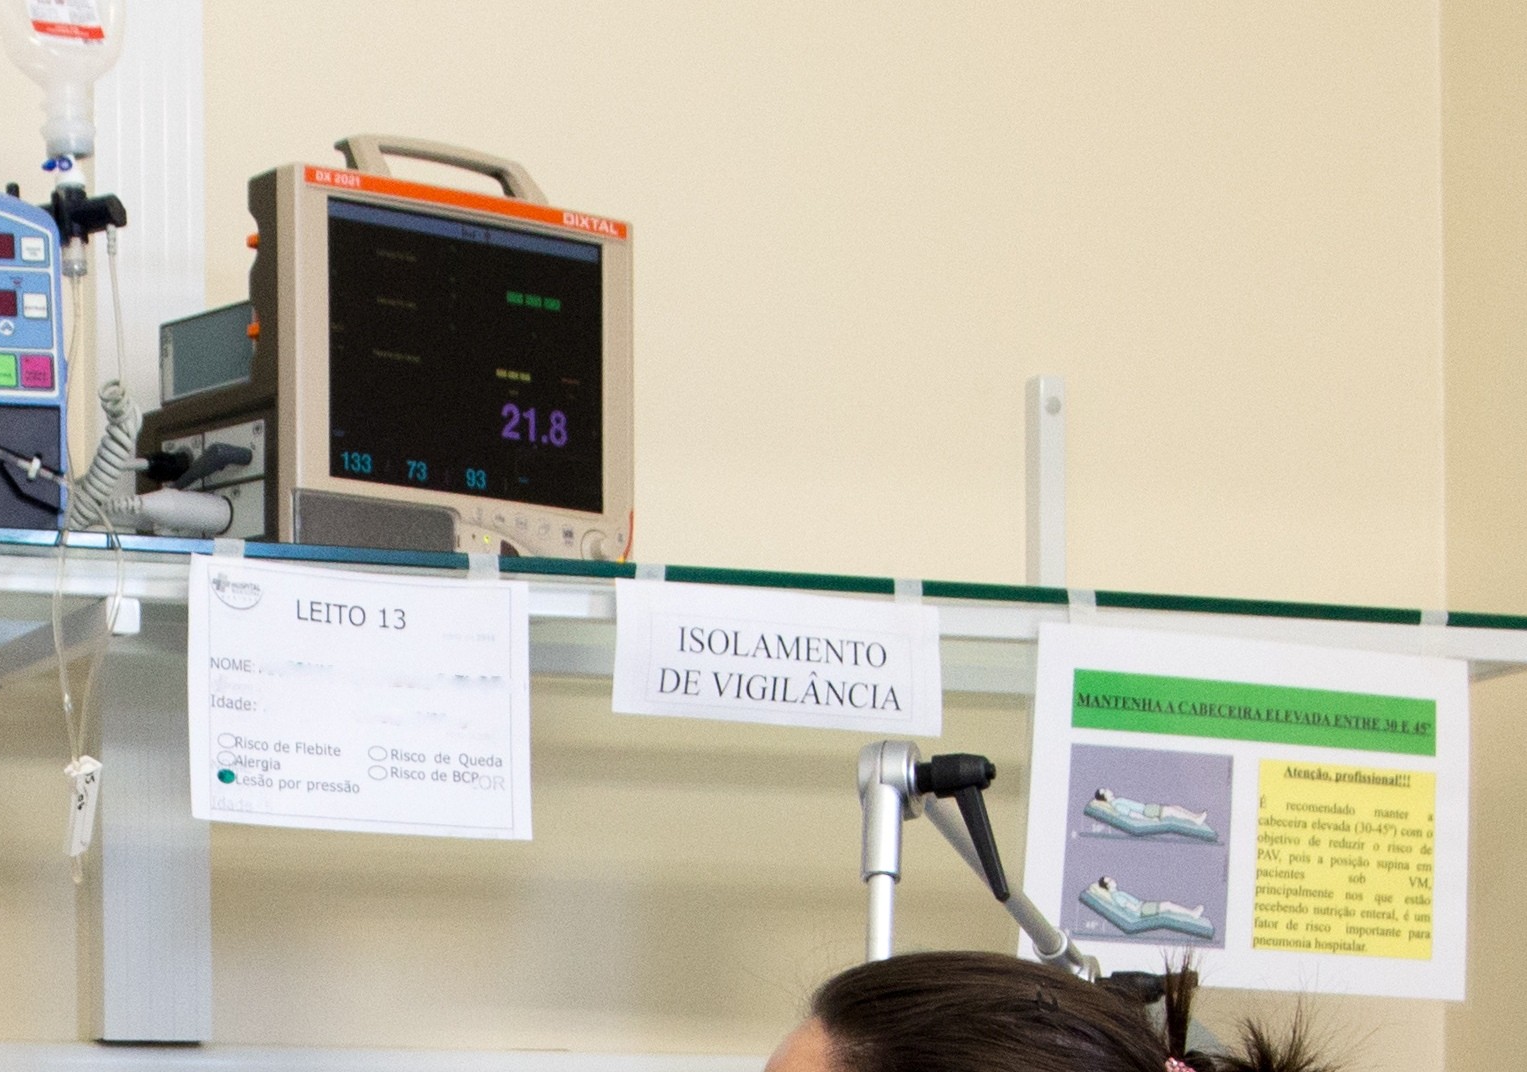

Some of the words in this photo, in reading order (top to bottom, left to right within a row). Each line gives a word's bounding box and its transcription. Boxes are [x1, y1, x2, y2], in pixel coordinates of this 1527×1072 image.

[315, 170, 332, 182] DX
[563, 211, 619, 237] DIXTAL
[501, 403, 568, 447] 21.8
[341, 451, 373, 474] 133
[407, 460, 429, 482] 73
[465, 468, 488, 490] 93
[296, 598, 366, 627] LEITO
[379, 608, 406, 630] 13
[678, 625, 887, 668] ISOLAMENTO
[210, 656, 256, 674] NOME:
[658, 667, 701, 697] DE
[712, 671, 902, 711] VIGILÂNCIA
[211, 694, 258, 712] Idade:
[1077, 692, 1162, 713] MANTENHA
[1165, 701, 1175, 714] A
[1177, 701, 1262, 720] CABECEIRA
[1265, 708, 1331, 727] ELEVADA
[1333, 714, 1382, 732] ENTRE
[1383, 719, 1398, 733] 30
[1400, 720, 1411, 734] E
[235, 736, 269, 752] Risco
[273, 740, 290, 753] de
[295, 741, 341, 757] Flebite
[234, 755, 281, 771] Alergia
[390, 749, 426, 763] Risco
[434, 752, 451, 764] de
[459, 753, 503, 768] Queda
[235, 773, 273, 788] Lesão
[279, 777, 301, 792] por
[307, 779, 360, 794] pressão
[390, 766, 426, 781] Risco
[431, 770, 447, 782] de
[453, 770, 479, 784] BCP
[1283, 766, 1332, 783] Atenção,
[1334, 770, 1411, 788] profissional!!!
[1286, 801, 1356, 816] recomendado
[1374, 807, 1409, 820] manter
[1427, 814, 1434, 822] a
[1258, 814, 1307, 829] cabeceira
[1311, 818, 1351, 833] elevada
[1400, 828, 1423, 838] com
[1426, 831, 1433, 839] o
[1257, 831, 1301, 847] objetivo
[1308, 834, 1321, 847] de
[1329, 838, 1365, 851] reduzir
[1387, 843, 1413, 854] risco
[1420, 843, 1432, 855] de
[1257, 849, 1282, 863] PAV,
[1289, 851, 1311, 866] pois
[1317, 856, 1324, 865] a
[1330, 856, 1370, 870] posição
[1377, 859, 1410, 873] supina
[1416, 862, 1432, 872] em
[1256, 866, 1305, 880] pacientes
[1348, 872, 1366, 885] sob
[1255, 883, 1334, 899] principalmente
[1345, 891, 1364, 901] nos
[1374, 893, 1393, 907] que
[1404, 893, 1431, 906] estão
[1254, 900, 1308, 915] recebendo
[1313, 904, 1356, 919] nutrição
[1360, 909, 1399, 922] enteral,
[1403, 911, 1409, 922] é
[1414, 913, 1431, 923] um
[1254, 916, 1278, 929] fator
[1286, 919, 1299, 931] de
[1305, 921, 1331, 933] risco
[1345, 924, 1402, 939] importante
[1408, 929, 1431, 941] para
[1252, 934, 1312, 949] pneumonia
[1314, 936, 1368, 953] hospitalar.
